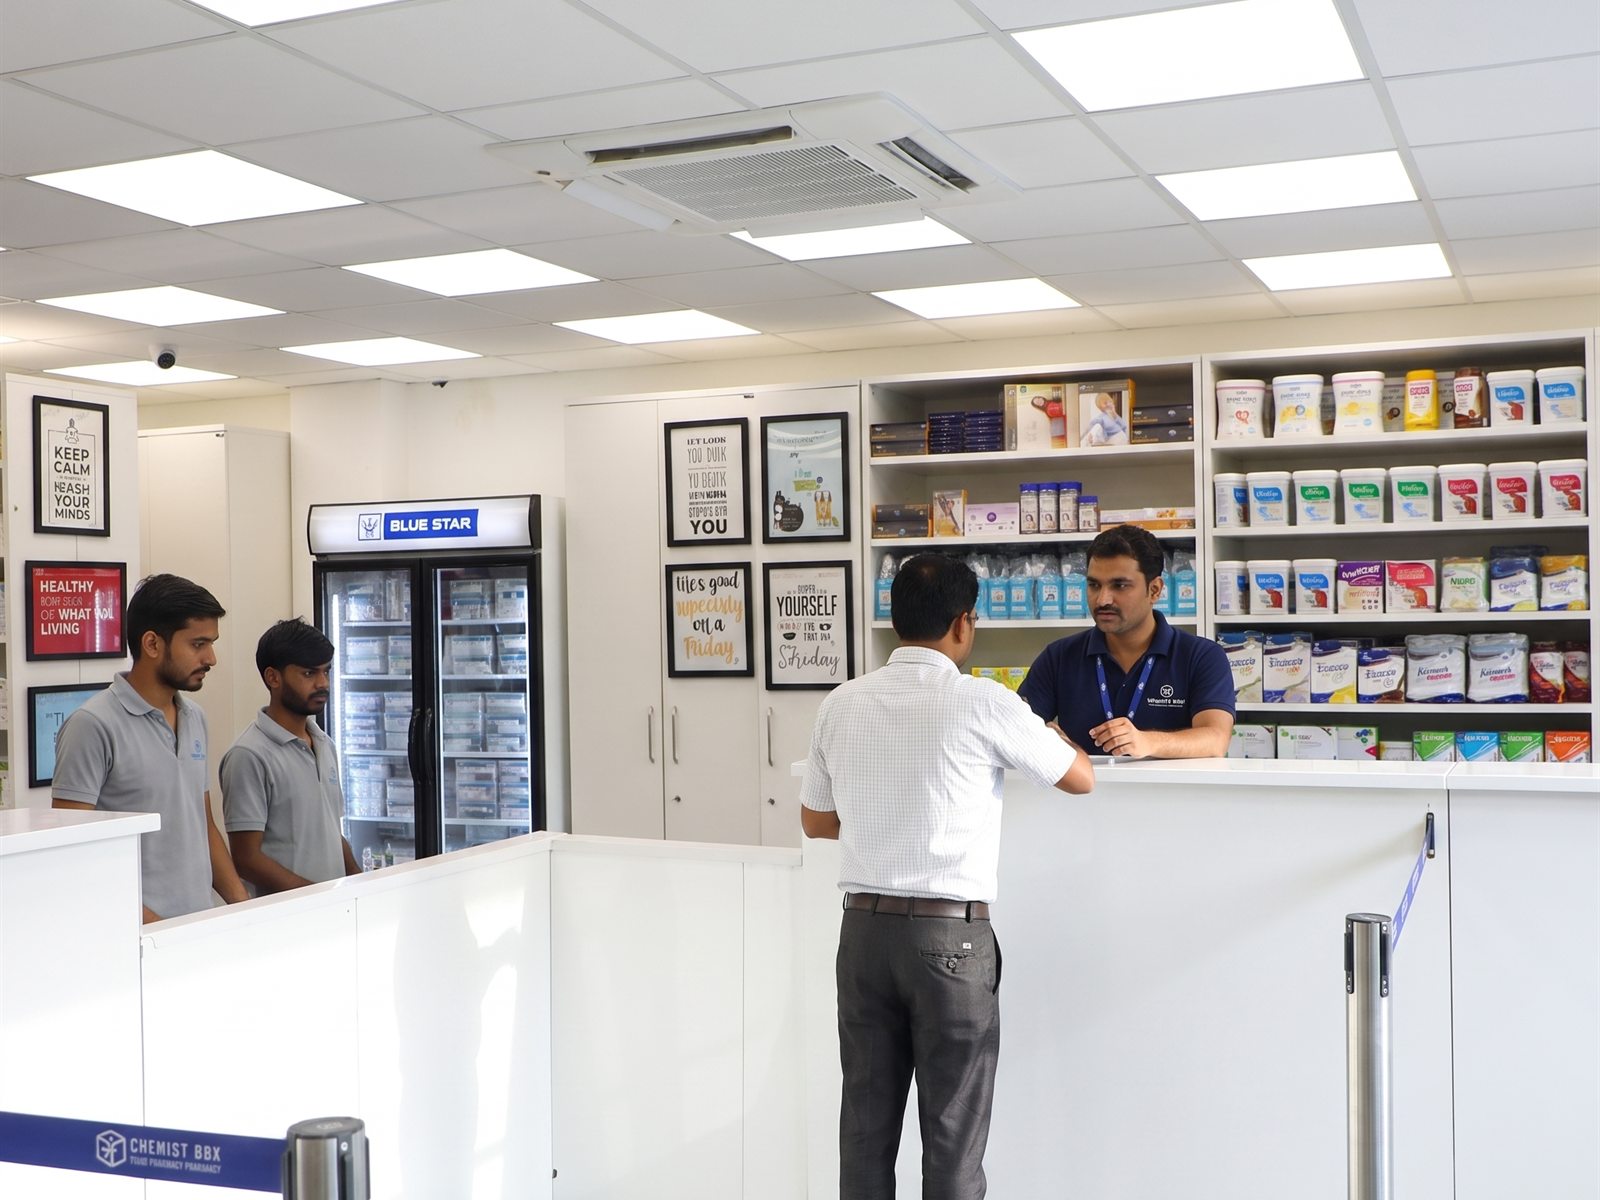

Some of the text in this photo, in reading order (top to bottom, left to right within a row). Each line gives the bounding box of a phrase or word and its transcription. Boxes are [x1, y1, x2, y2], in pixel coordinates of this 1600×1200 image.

[54, 446, 90, 462] KEEP
[54, 461, 90, 476] CALM
[54, 494, 90, 509] YOUR
[55, 508, 90, 521] MINDS
[390, 517, 471, 532] BLUE STAR
[689, 518, 728, 535] YOU
[40, 580, 94, 593] HEALTHY
[776, 595, 838, 617] YOURSELF
[58, 608, 92, 621] WHAT
[41, 622, 80, 635] LIVING
[130, 1137, 221, 1162] CHEMIST BBX
